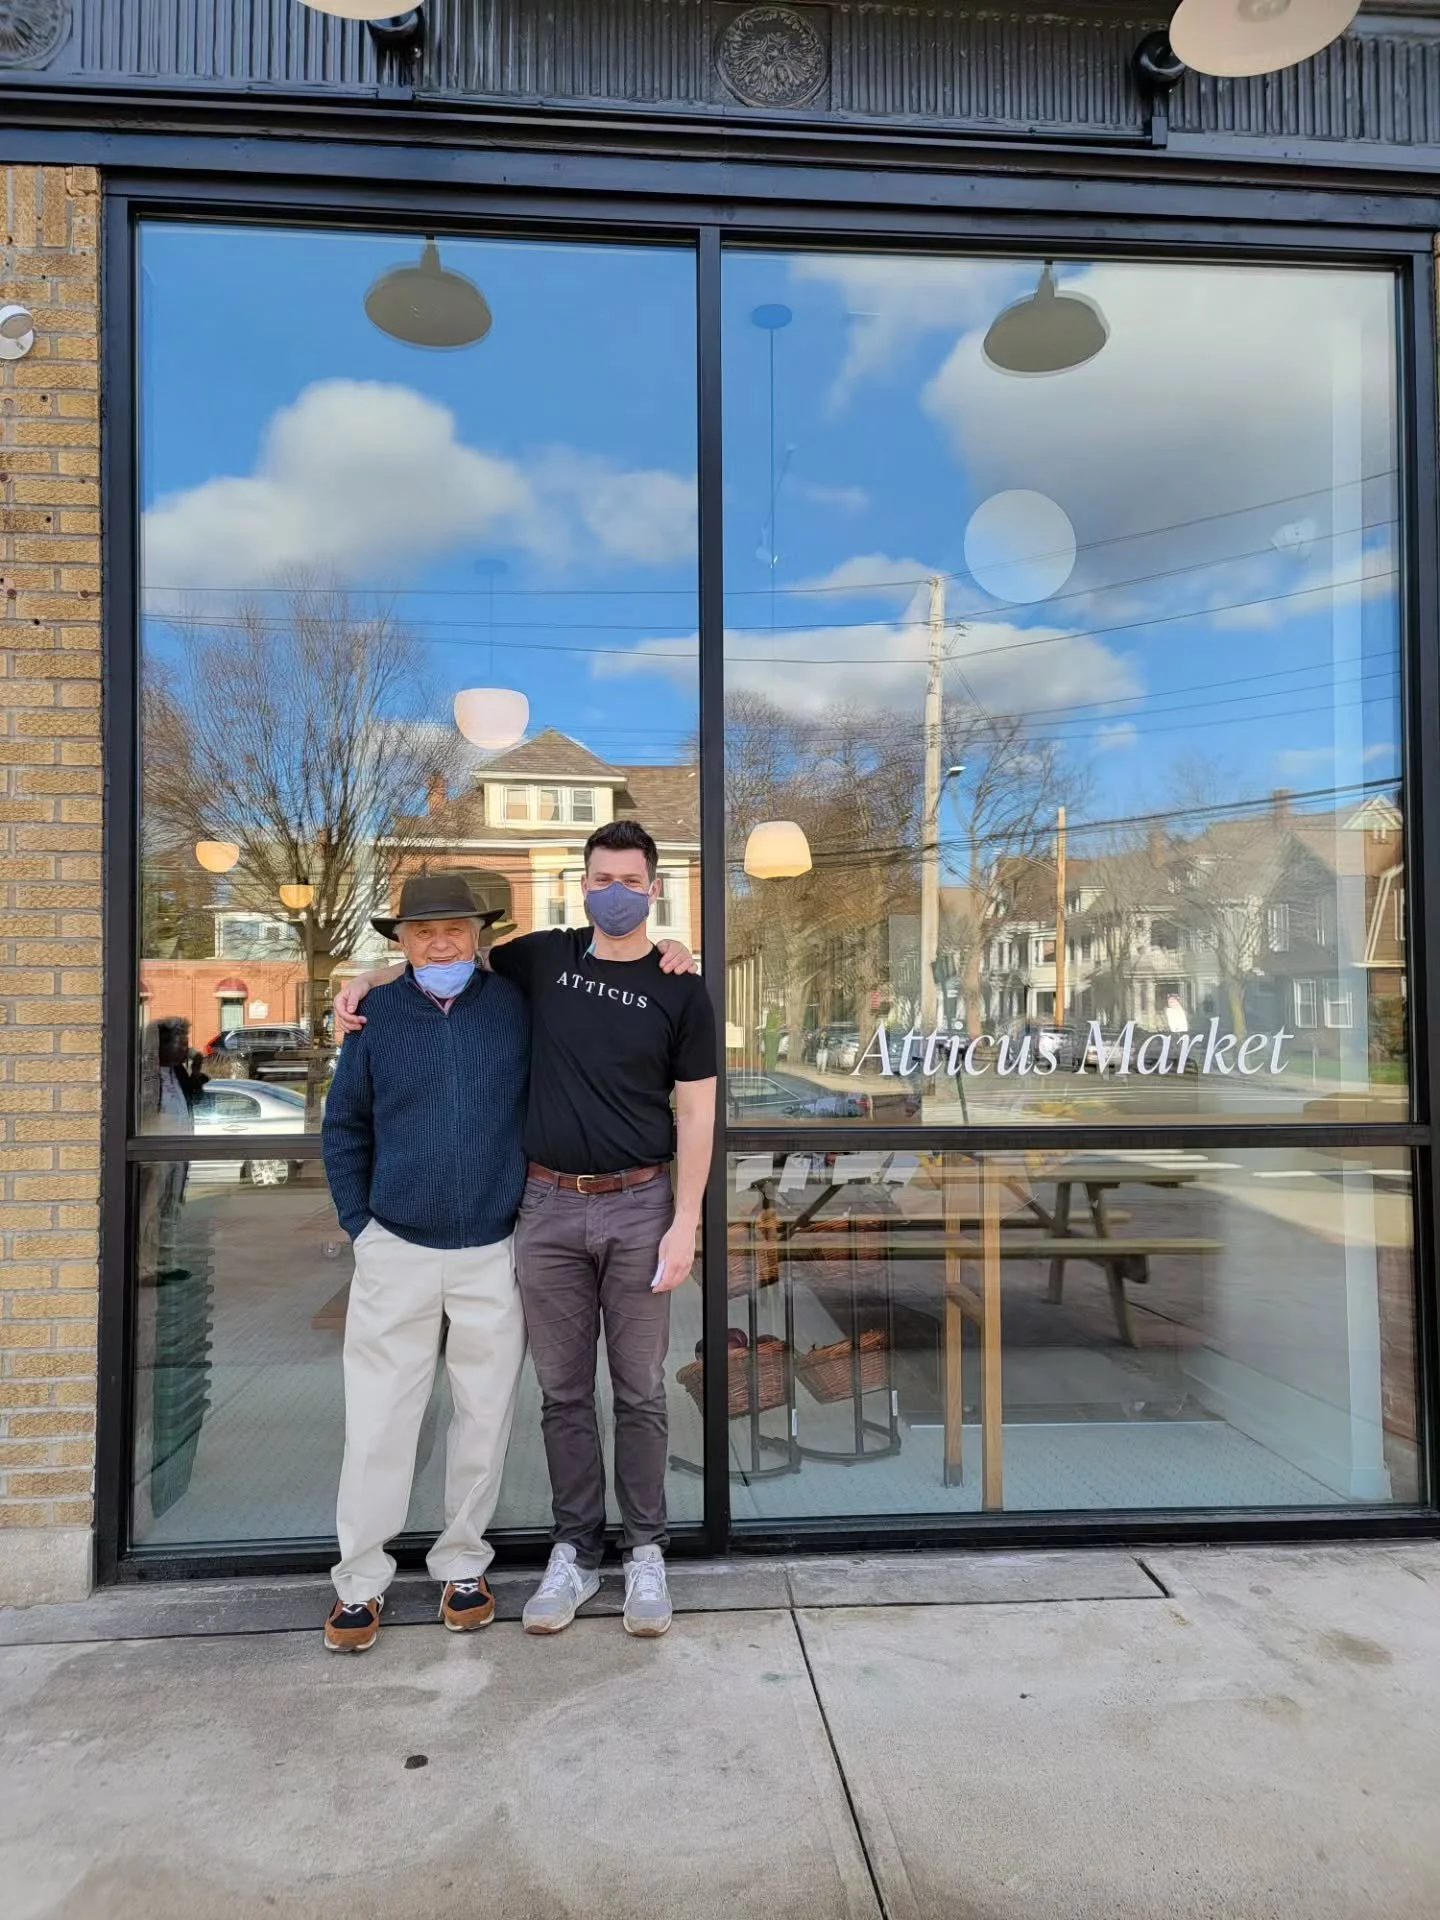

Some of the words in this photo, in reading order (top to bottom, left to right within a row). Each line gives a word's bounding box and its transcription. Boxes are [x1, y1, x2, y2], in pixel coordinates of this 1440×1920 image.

[556, 971, 648, 1009] ATTICUS
[850, 1020, 1057, 1077] Atticus
[1077, 1016, 1294, 1076] Market
